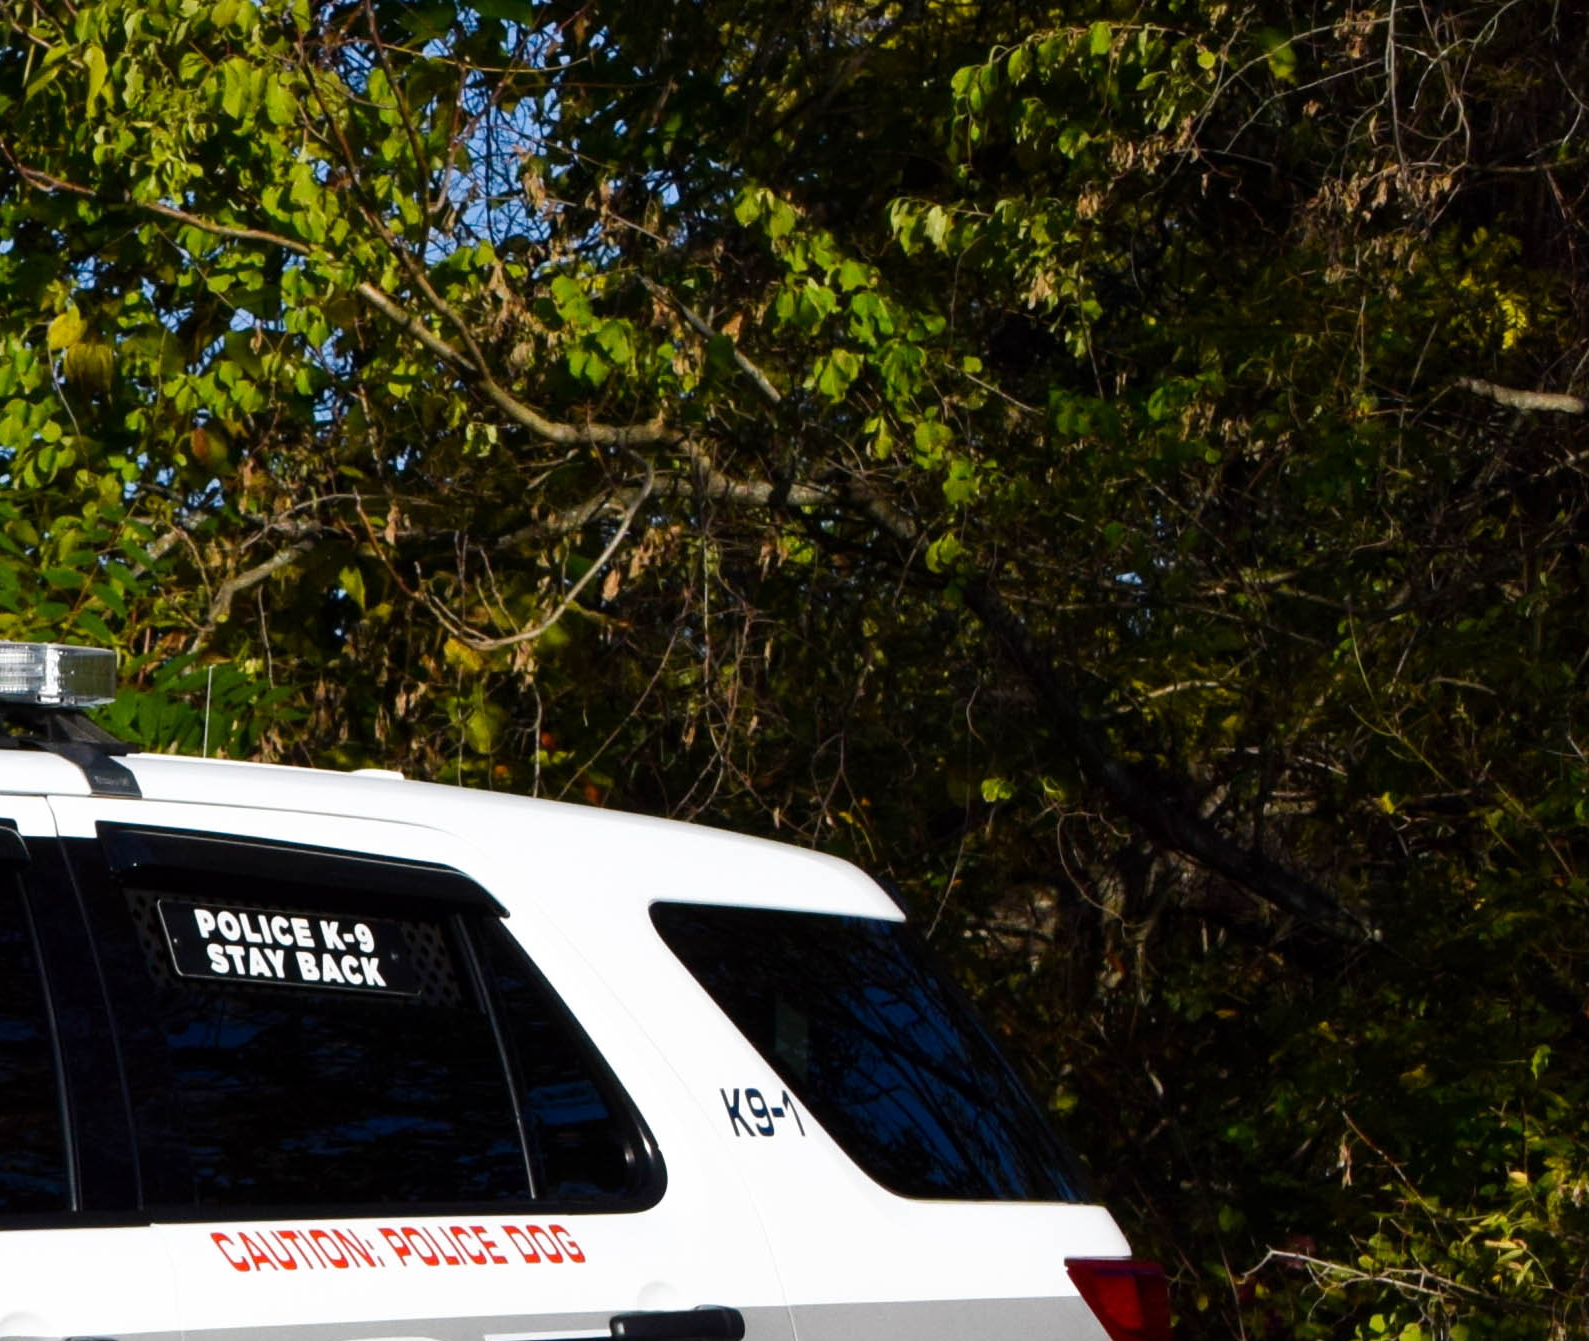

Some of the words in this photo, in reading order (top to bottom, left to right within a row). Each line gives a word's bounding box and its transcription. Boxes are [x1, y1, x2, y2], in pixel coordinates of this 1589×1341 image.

[194, 908, 316, 948] POLICE
[319, 919, 376, 954] K-9
[207, 943, 286, 979] STAY
[295, 951, 388, 988] BACK
[719, 1087, 806, 1137] K9-1
[209, 1228, 387, 1273] CAUTION:
[377, 1225, 510, 1267] POLICE
[501, 1224, 586, 1264] DOG
